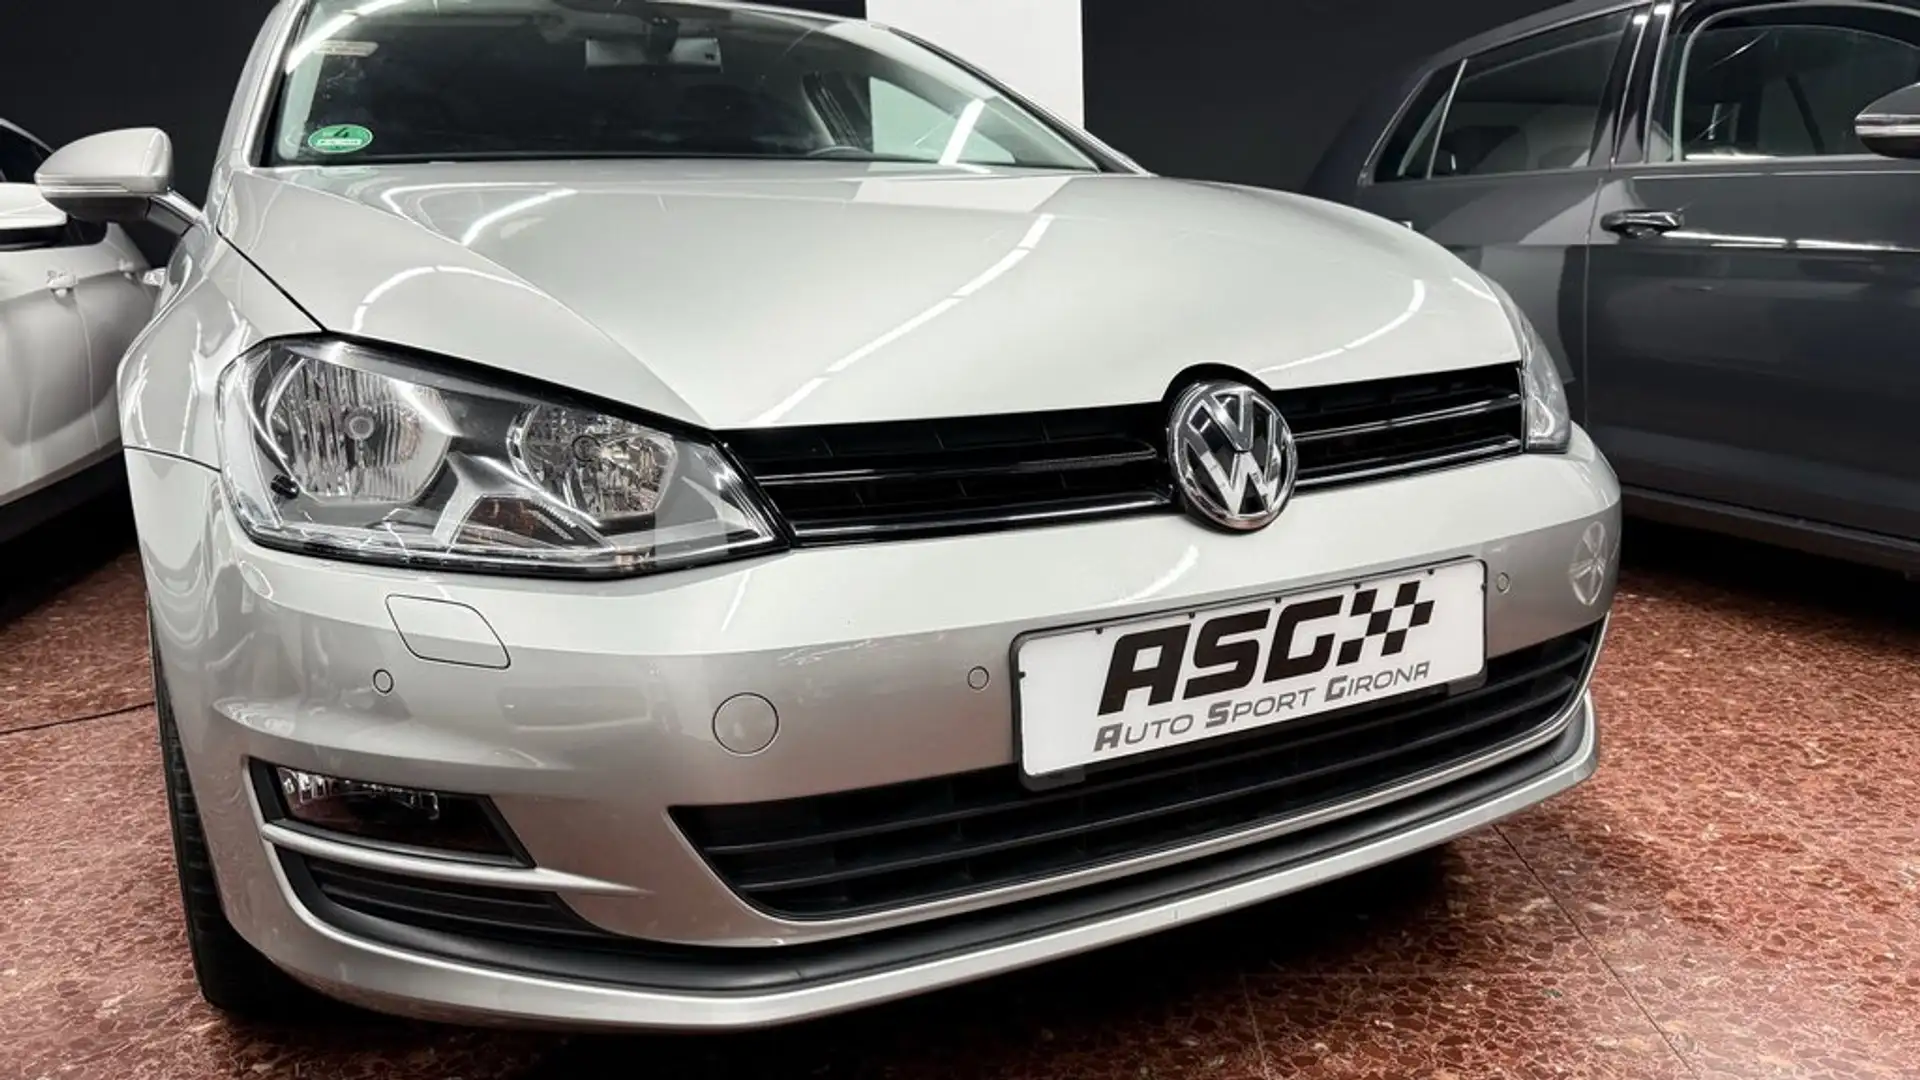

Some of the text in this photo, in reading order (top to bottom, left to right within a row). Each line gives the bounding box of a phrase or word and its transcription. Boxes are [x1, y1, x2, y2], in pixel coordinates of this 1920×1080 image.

[1178, 386, 1287, 520] VW
[1094, 661, 1431, 752] AUTO SPORT GIRONA
[1098, 594, 1345, 715] ASG
